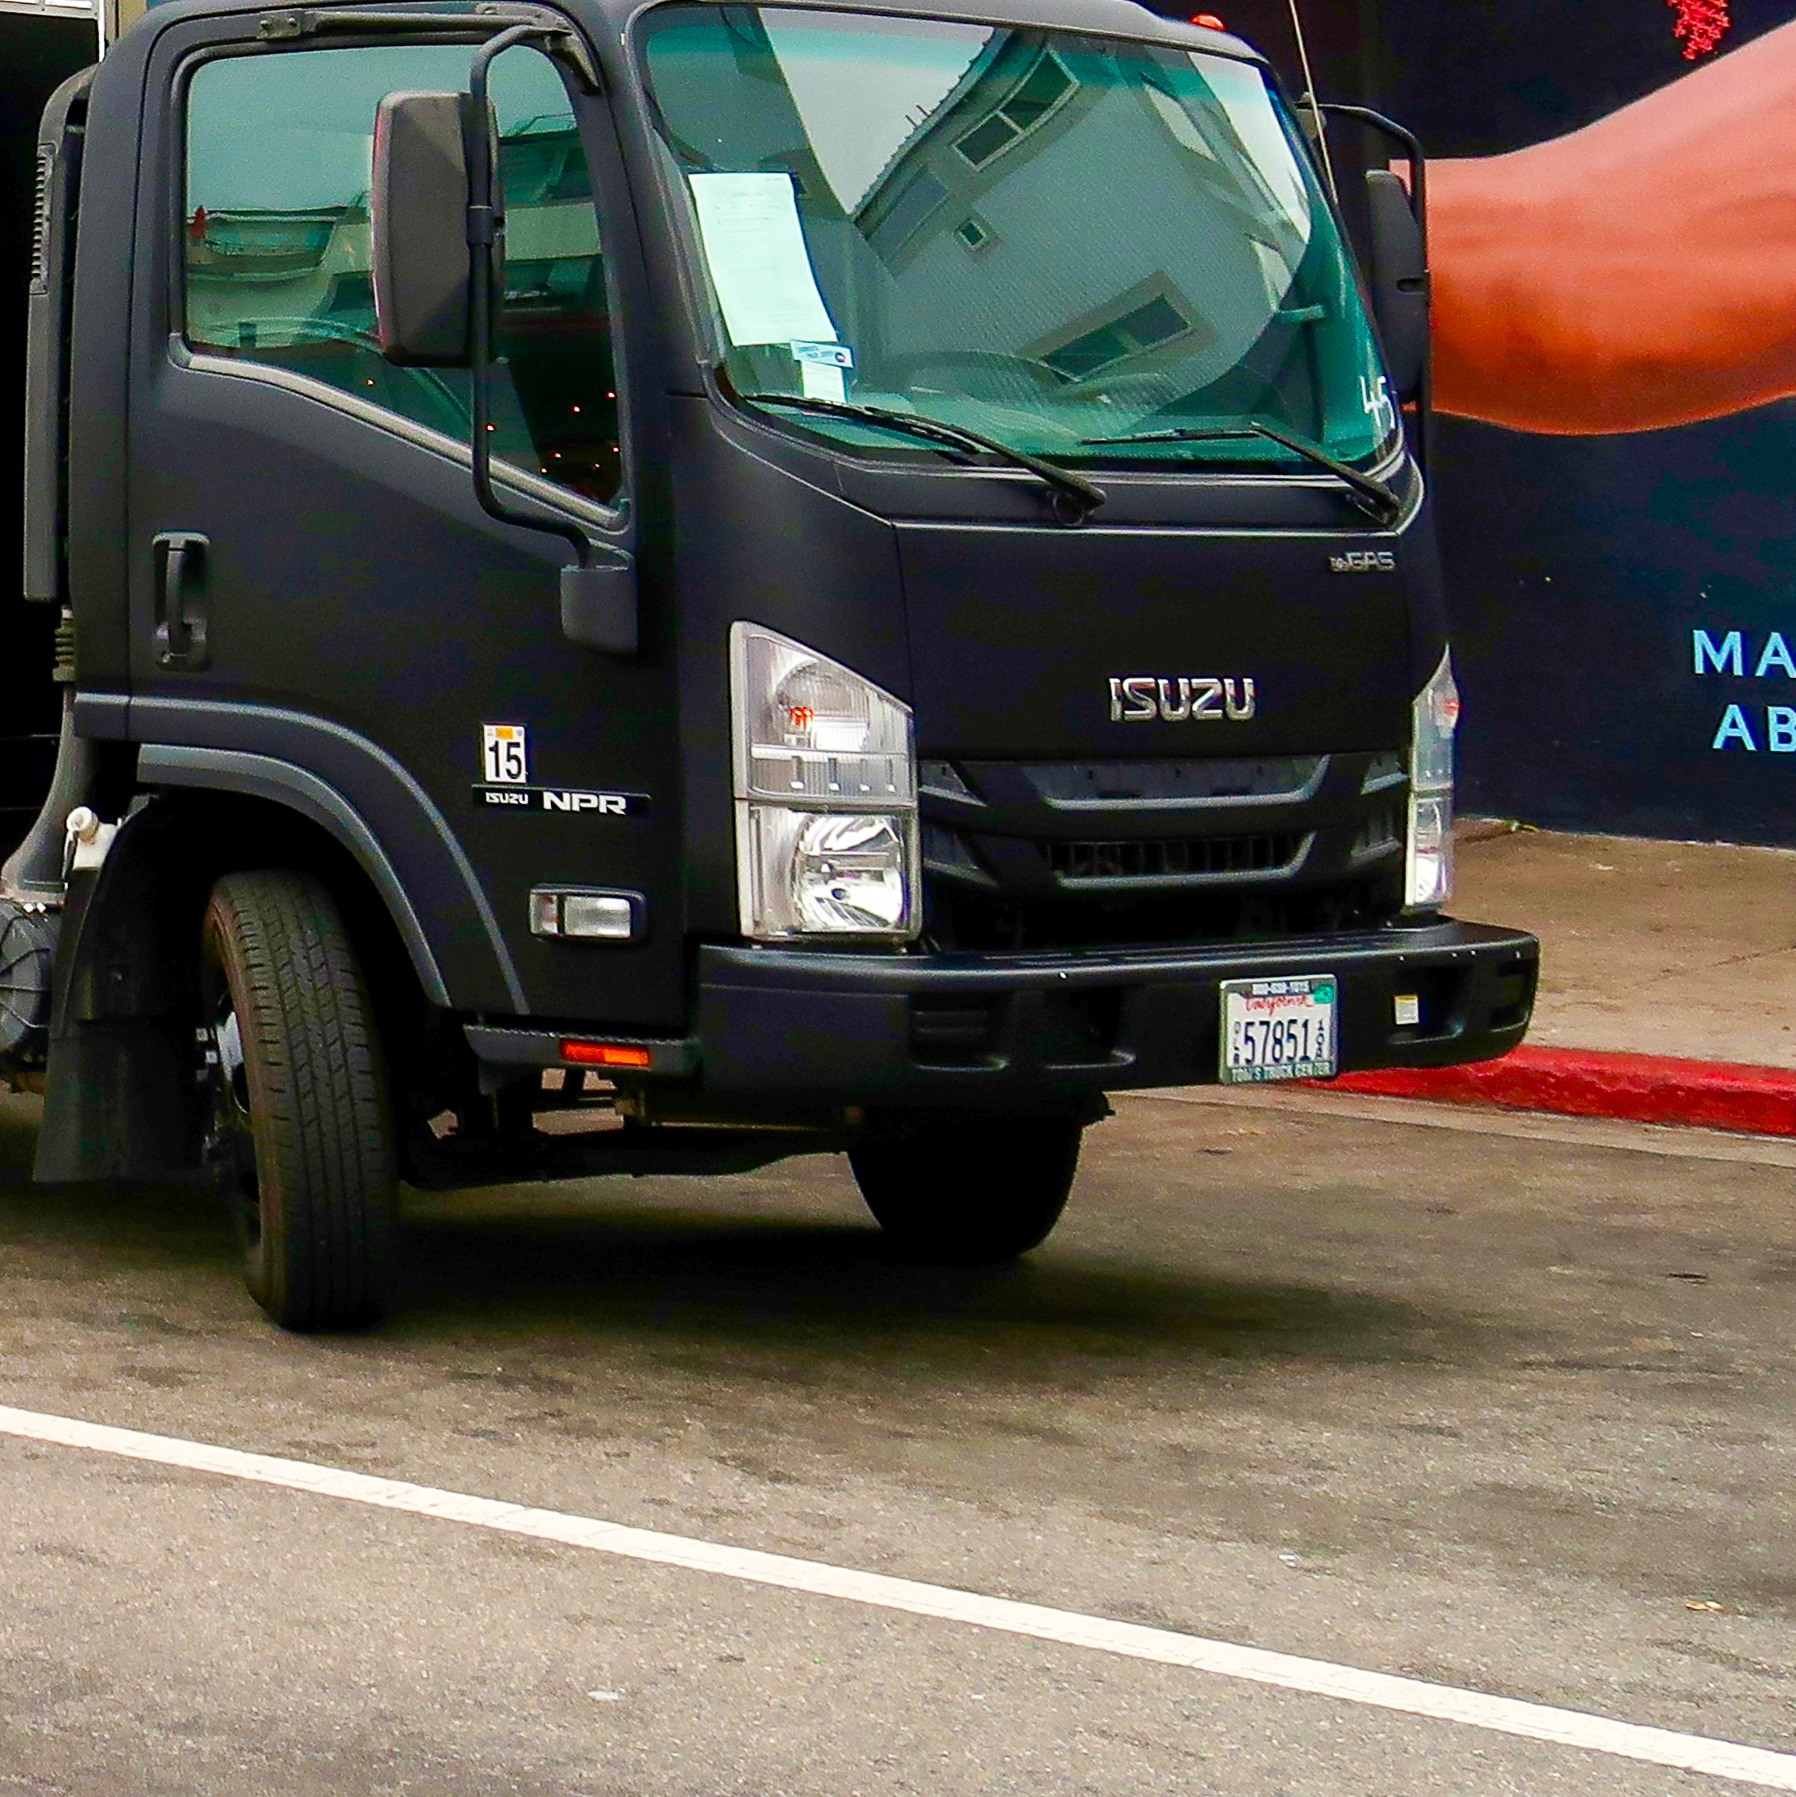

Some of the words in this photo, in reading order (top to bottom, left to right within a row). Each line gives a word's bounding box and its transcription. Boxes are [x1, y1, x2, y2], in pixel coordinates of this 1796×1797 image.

[1693, 629, 1796, 679] MA
[1108, 675, 1259, 723] ISUZU
[1712, 704, 1796, 752] AB
[488, 740, 522, 780] 15
[485, 791, 529, 805] ISUZU
[543, 791, 627, 816] NPR
[1244, 1018, 1311, 1065] 57851
[1266, 1064, 1293, 1079] TRUCK
[1295, 1062, 1330, 1077] CENTER
